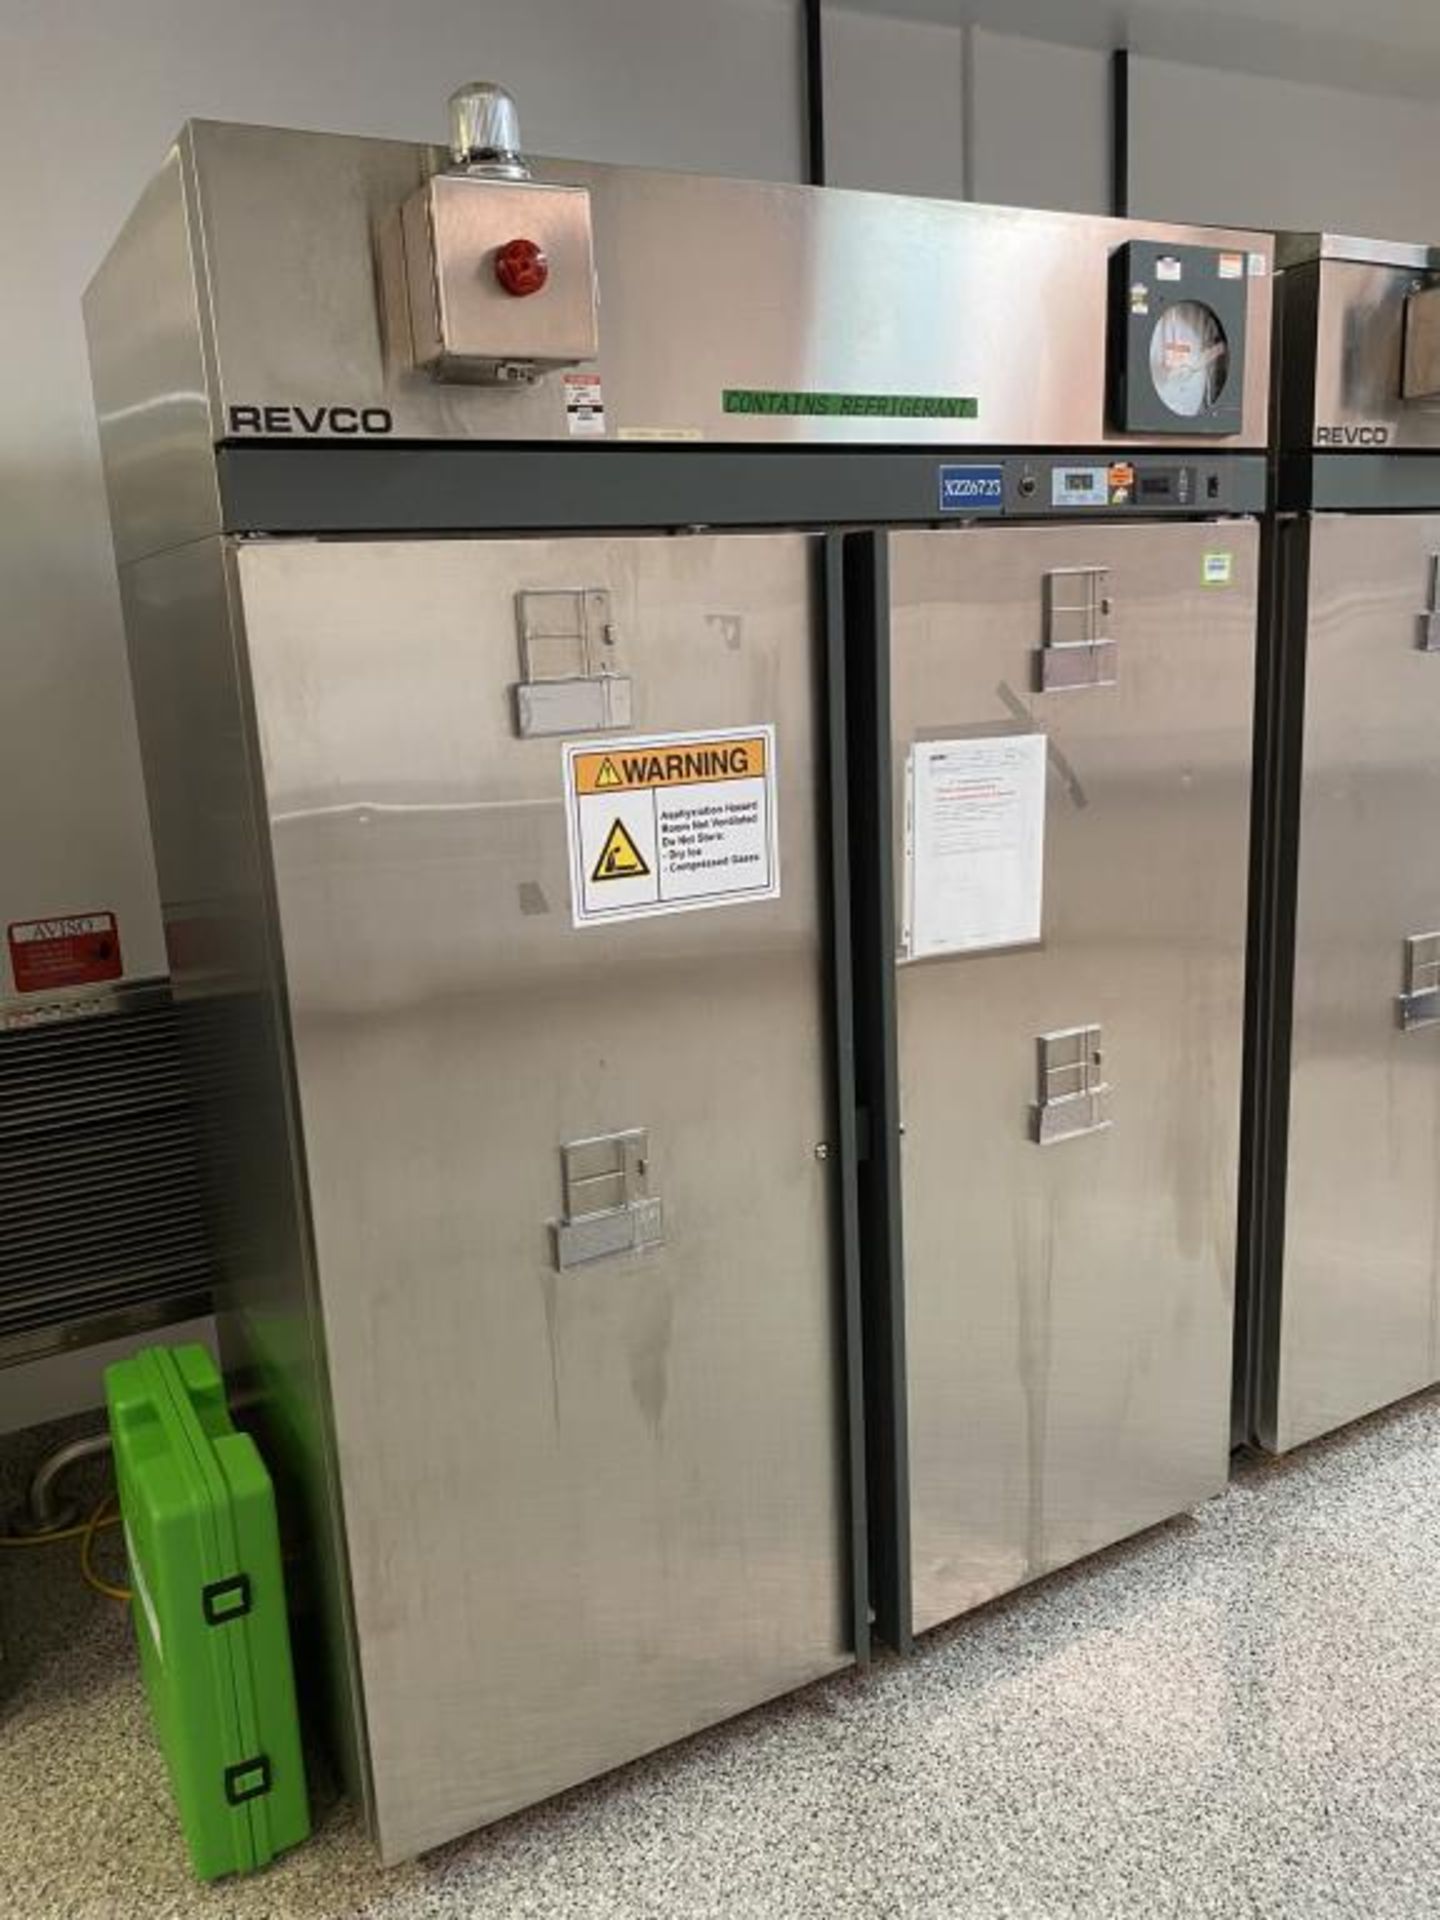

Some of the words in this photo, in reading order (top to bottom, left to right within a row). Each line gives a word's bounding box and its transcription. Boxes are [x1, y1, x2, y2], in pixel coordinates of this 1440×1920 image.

[725, 391, 829, 414] CONTAINS
[840, 395, 970, 417] REFRIGERANT
[230, 406, 392, 433] REVCO
[1317, 427, 1388, 443] REVCO
[622, 747, 748, 783] WARNING
[662, 836, 676, 848] Do
[34, 919, 94, 940] AVISO
